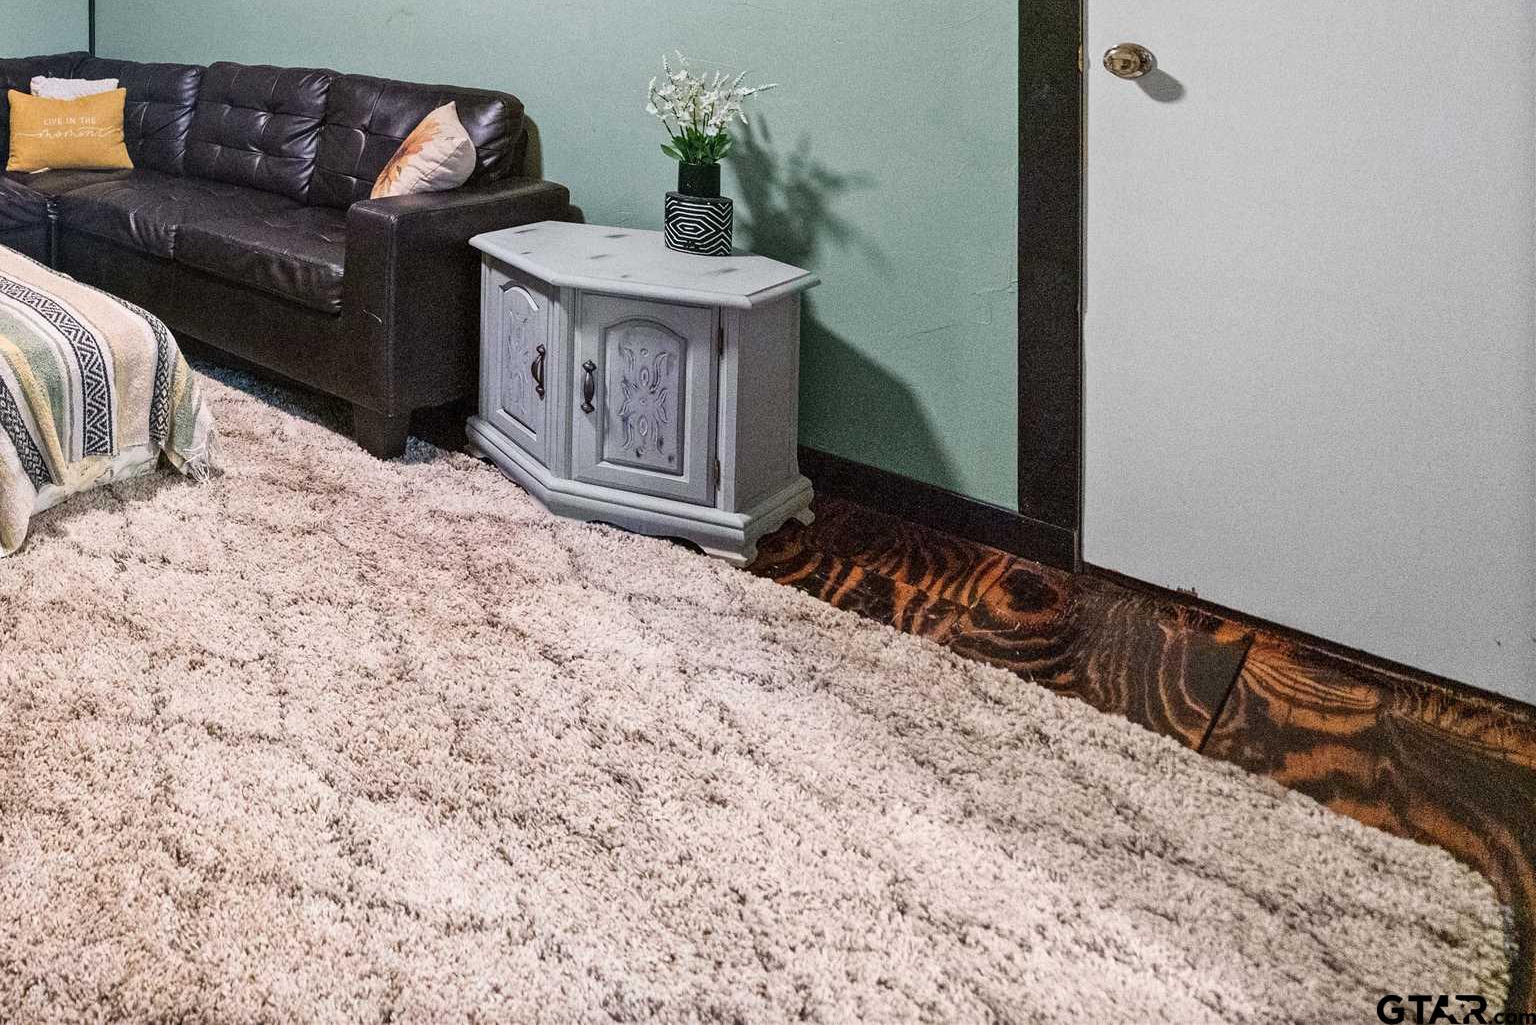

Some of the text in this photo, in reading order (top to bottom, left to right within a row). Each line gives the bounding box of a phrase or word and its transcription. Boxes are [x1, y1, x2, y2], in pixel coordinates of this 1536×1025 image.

[43, 116, 97, 126] LIVE IN THE
